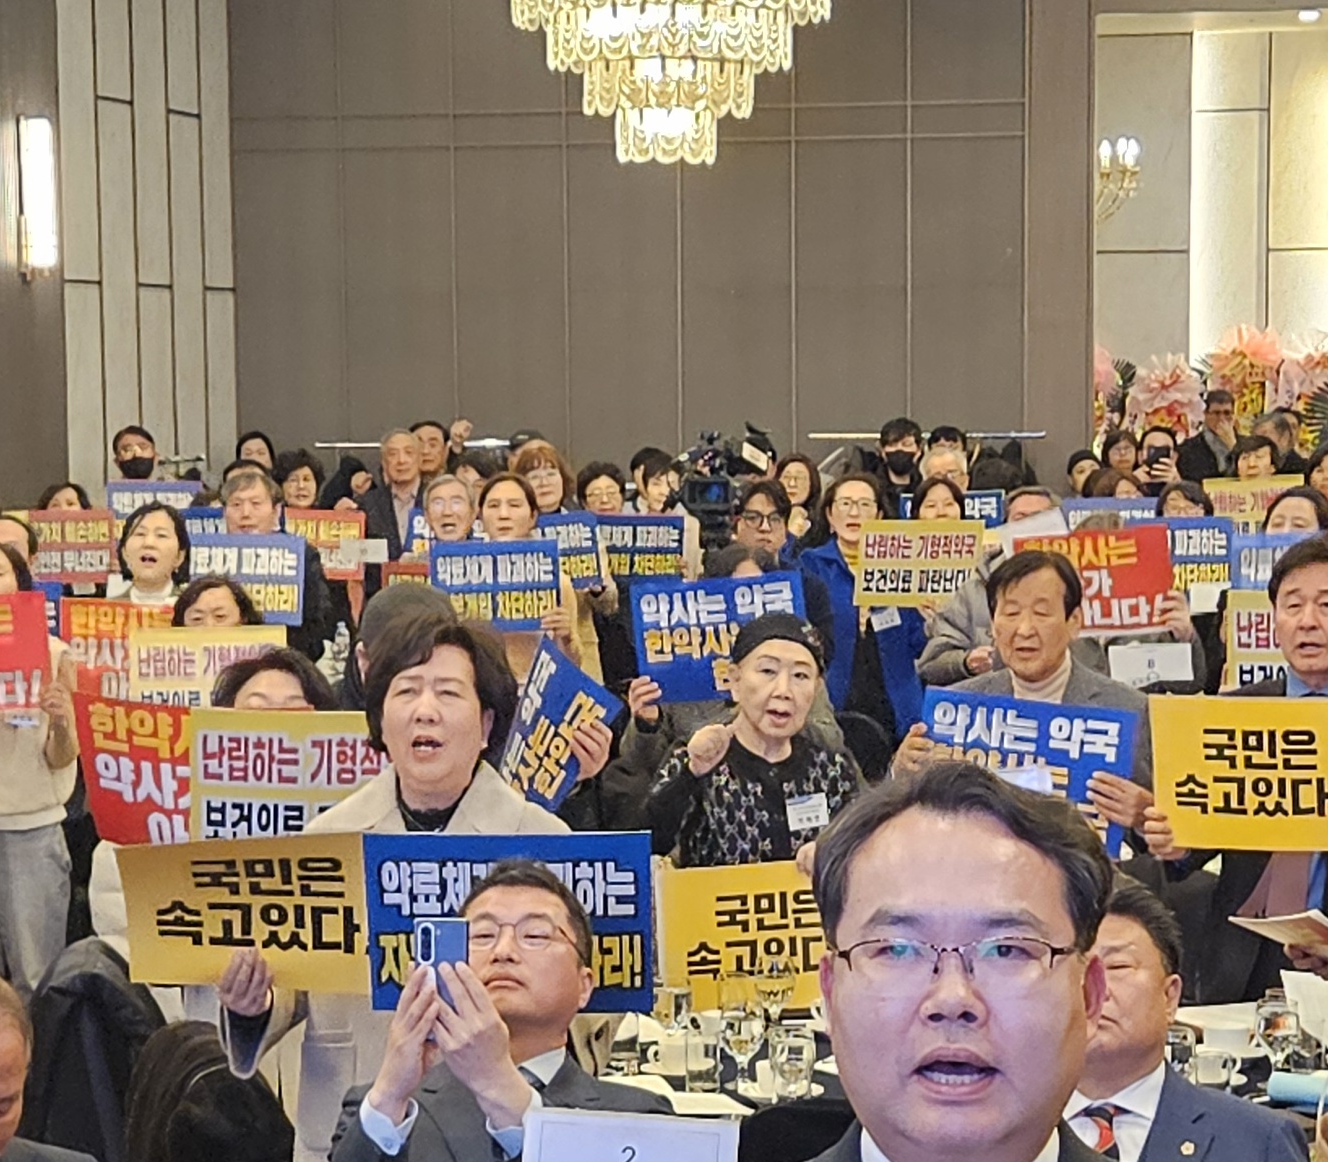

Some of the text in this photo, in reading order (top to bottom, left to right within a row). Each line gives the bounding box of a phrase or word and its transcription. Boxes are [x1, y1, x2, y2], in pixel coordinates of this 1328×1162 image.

[864, 534, 977, 560] 난립하는 기형적약국
[862, 569, 913, 593] 보건의료
[640, 590, 727, 626] 약사는
[643, 624, 738, 664] 한약사
[932, 700, 1121, 763] 약사는 약국
[1202, 727, 1319, 772] 국민은
[201, 732, 300, 785] 난립하는
[190, 856, 346, 898] 국민은
[154, 897, 363, 958] 속고있다
[715, 888, 823, 933] 국민은
